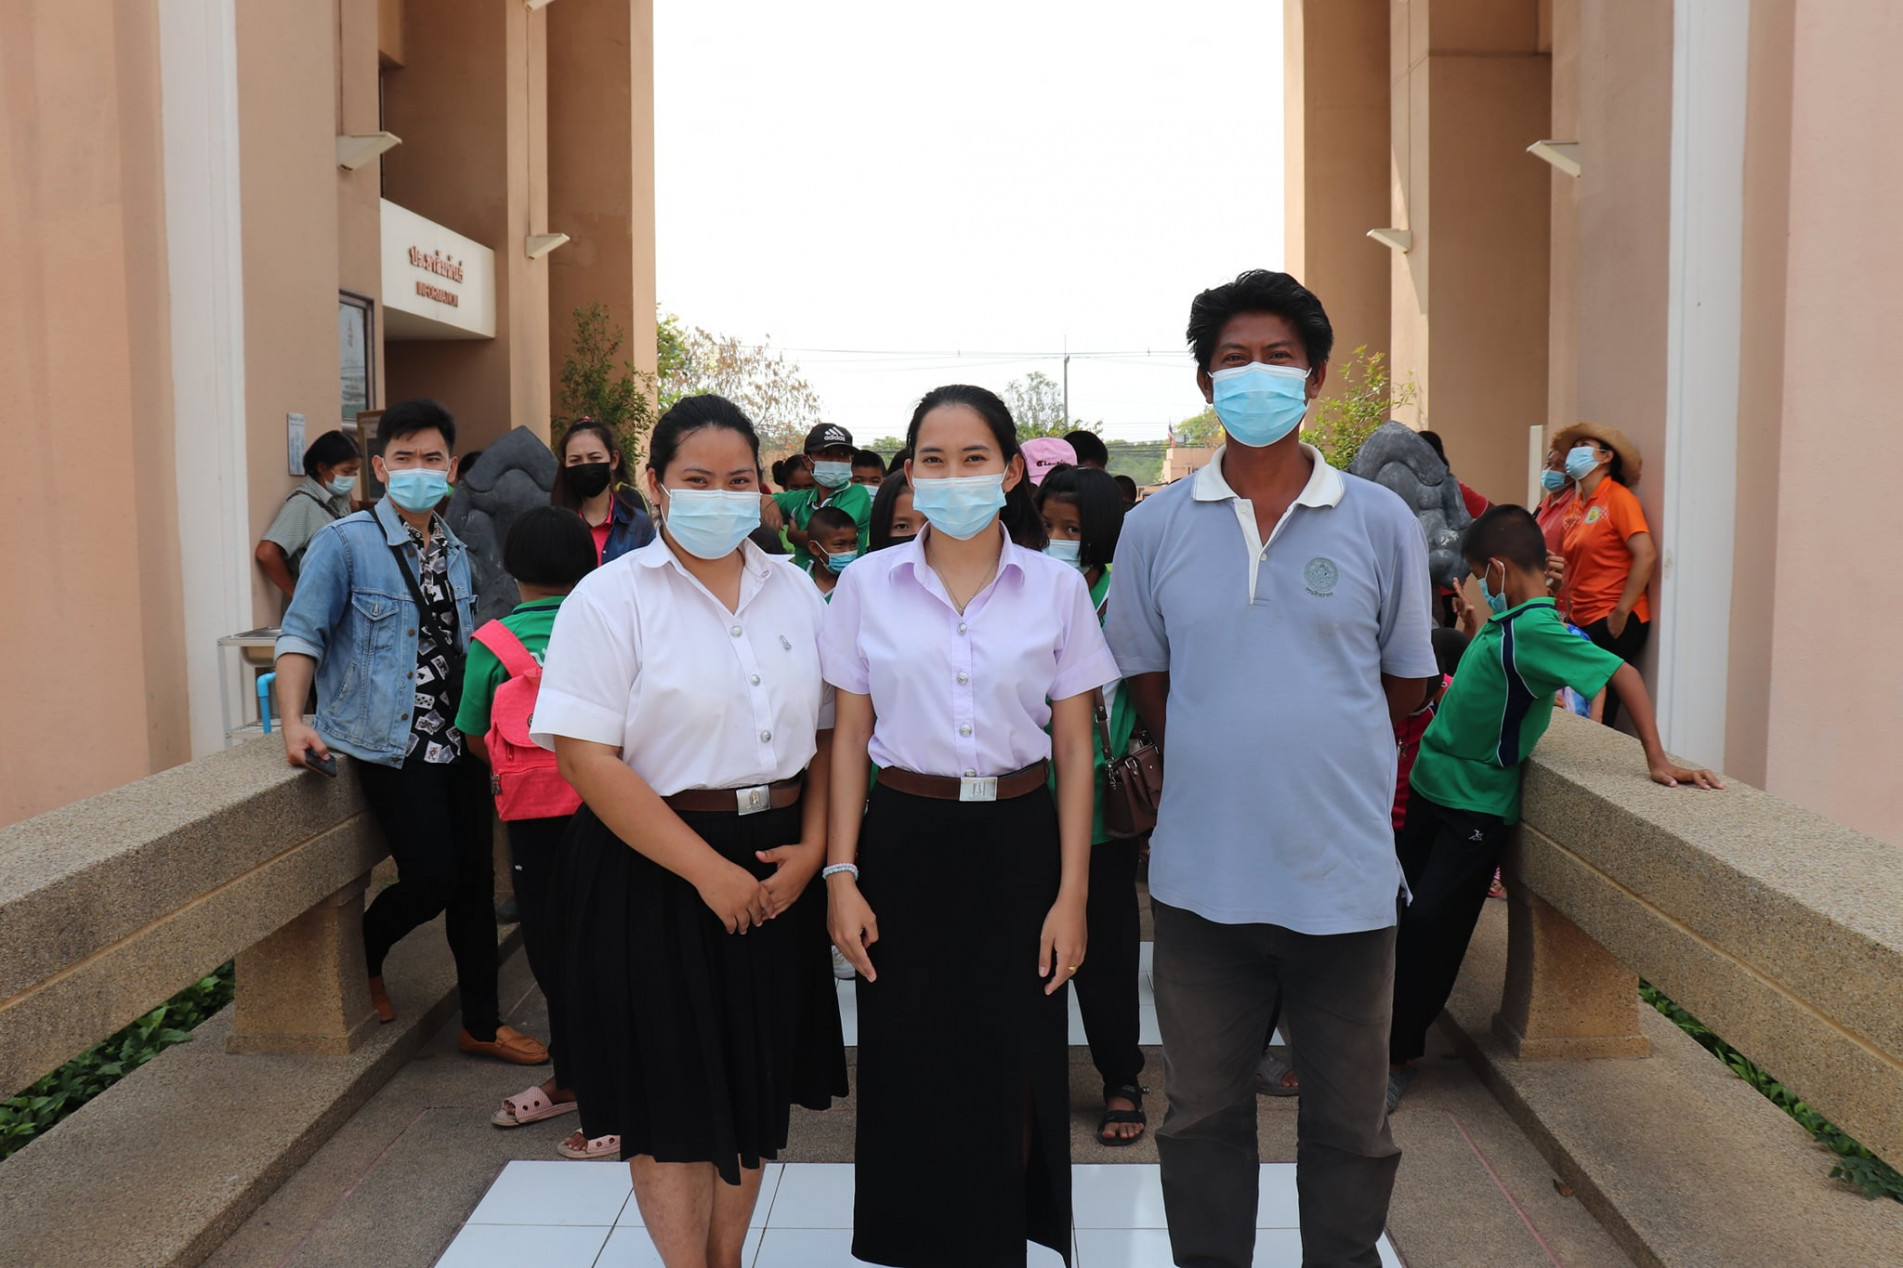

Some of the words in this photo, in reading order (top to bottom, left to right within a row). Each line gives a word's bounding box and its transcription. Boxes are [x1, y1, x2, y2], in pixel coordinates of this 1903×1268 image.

[408, 246, 463, 284] ประชาสัมพันธ์
[416, 281, 458, 307] INFORMATION
[824, 434, 845, 442] adidas
